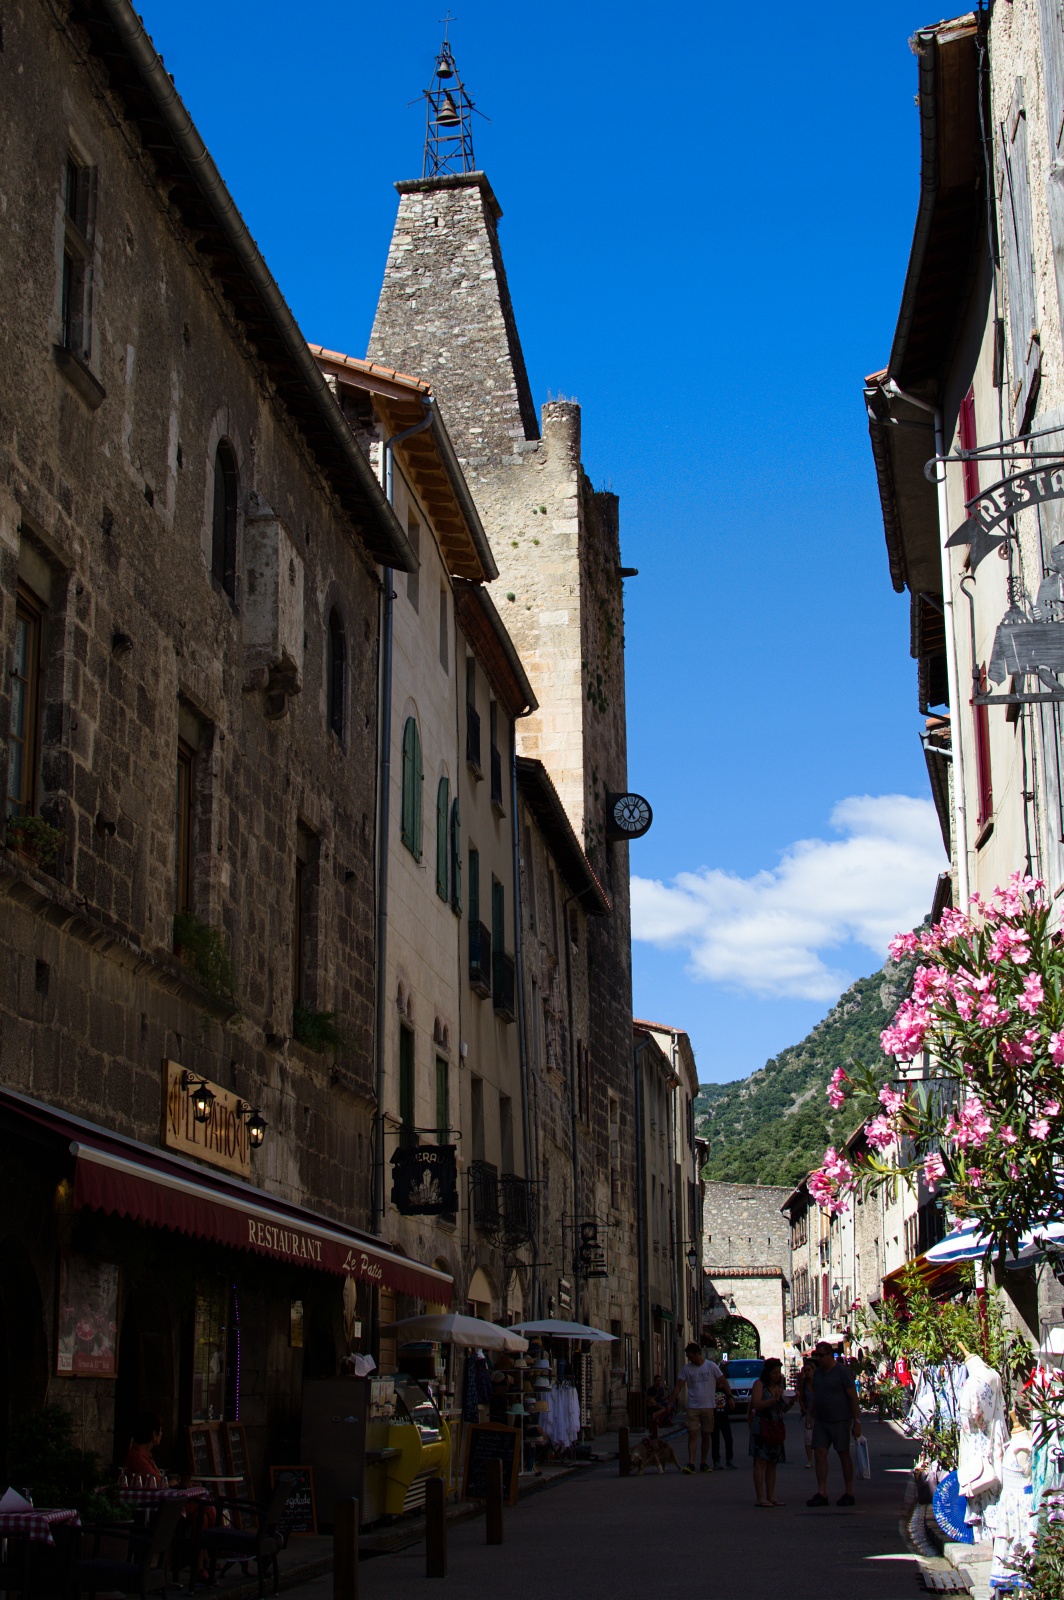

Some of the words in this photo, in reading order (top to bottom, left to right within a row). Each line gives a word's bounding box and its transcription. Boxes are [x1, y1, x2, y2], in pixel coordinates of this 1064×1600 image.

[248, 1219, 322, 1262] RESTAURANT
[342, 1249, 357, 1271] Le
[360, 1253, 383, 1279] Patio
